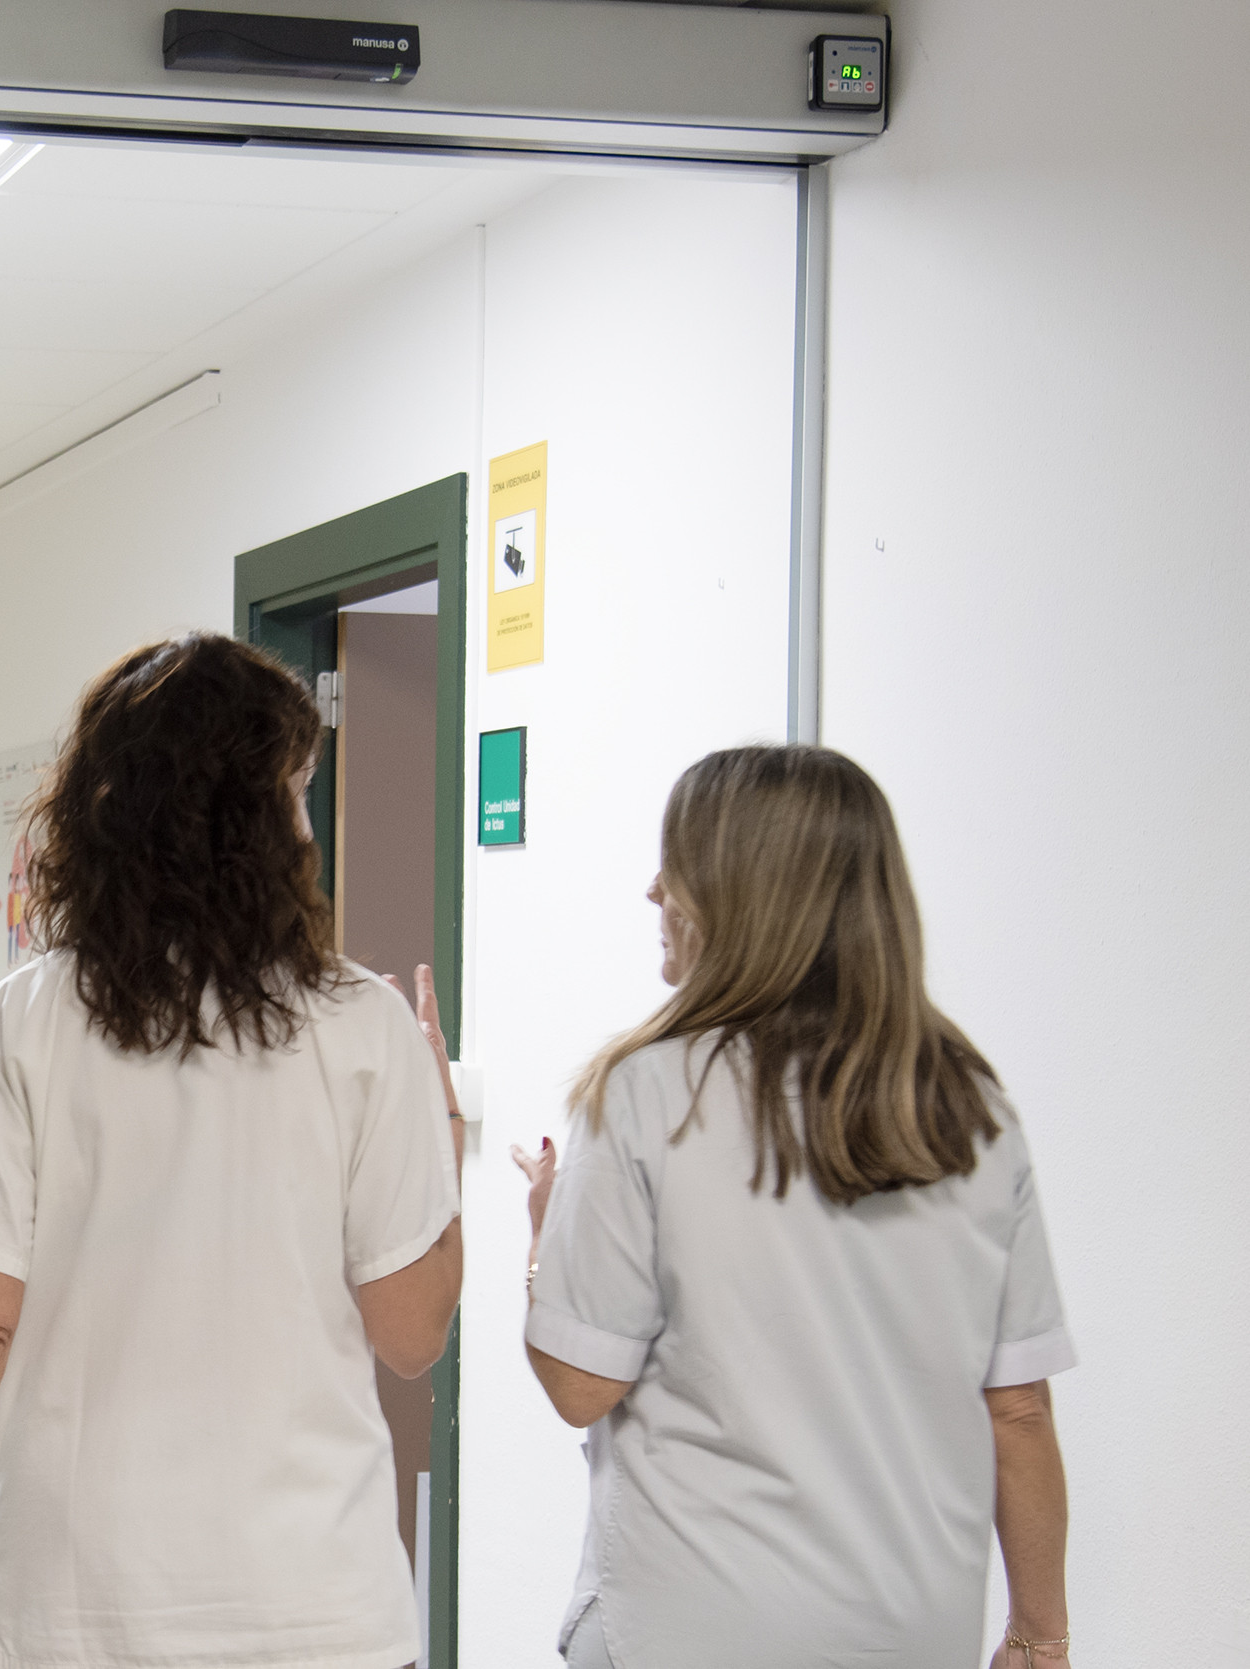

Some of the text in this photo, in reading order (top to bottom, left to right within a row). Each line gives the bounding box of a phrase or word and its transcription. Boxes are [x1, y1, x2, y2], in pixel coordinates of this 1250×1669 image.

[352, 37, 395, 49] manusa
[492, 481, 505, 494] ZONA
[484, 798, 520, 815] Control Unidad
[484, 817, 505, 832] de Ictus
